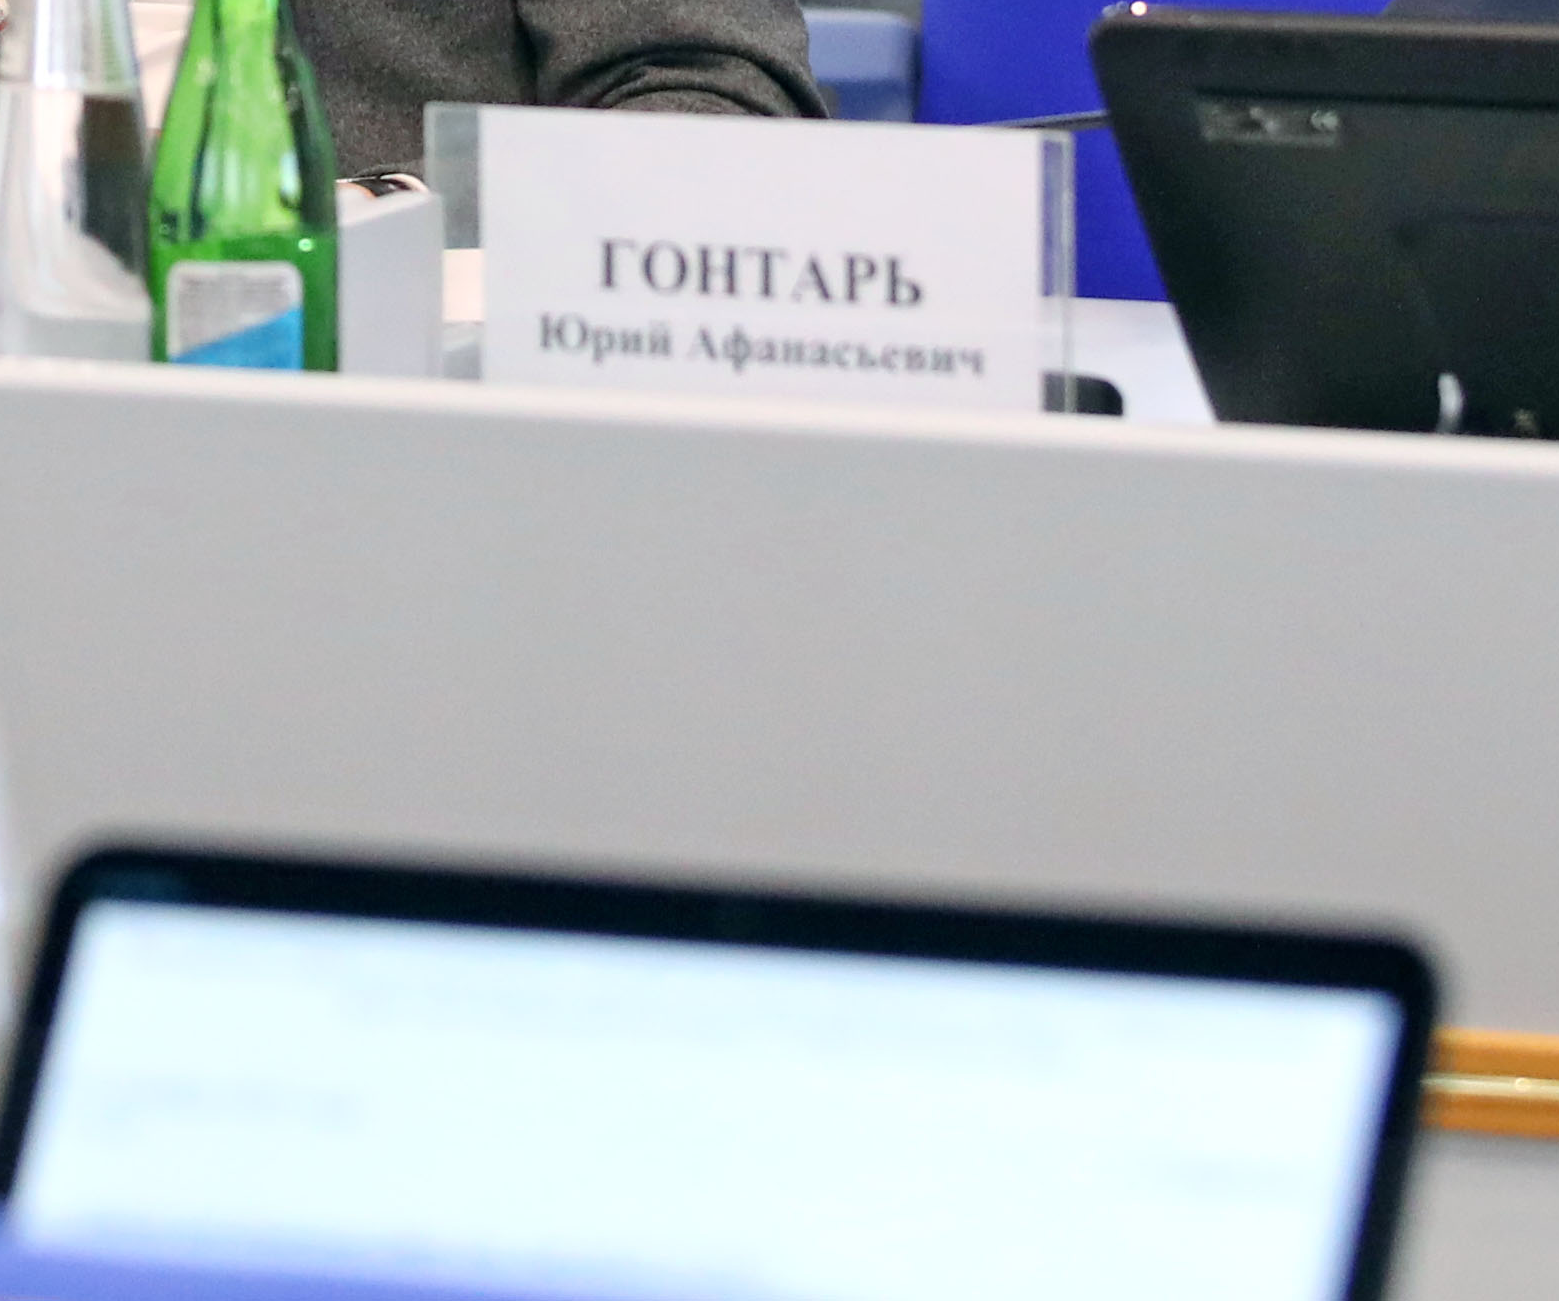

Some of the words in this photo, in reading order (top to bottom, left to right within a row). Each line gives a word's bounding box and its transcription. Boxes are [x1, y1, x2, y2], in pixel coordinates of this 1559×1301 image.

[600, 238, 923, 307] ГОНТАРЬ
[539, 312, 673, 365] Юрий
[688, 324, 985, 378] Афанасьевич
